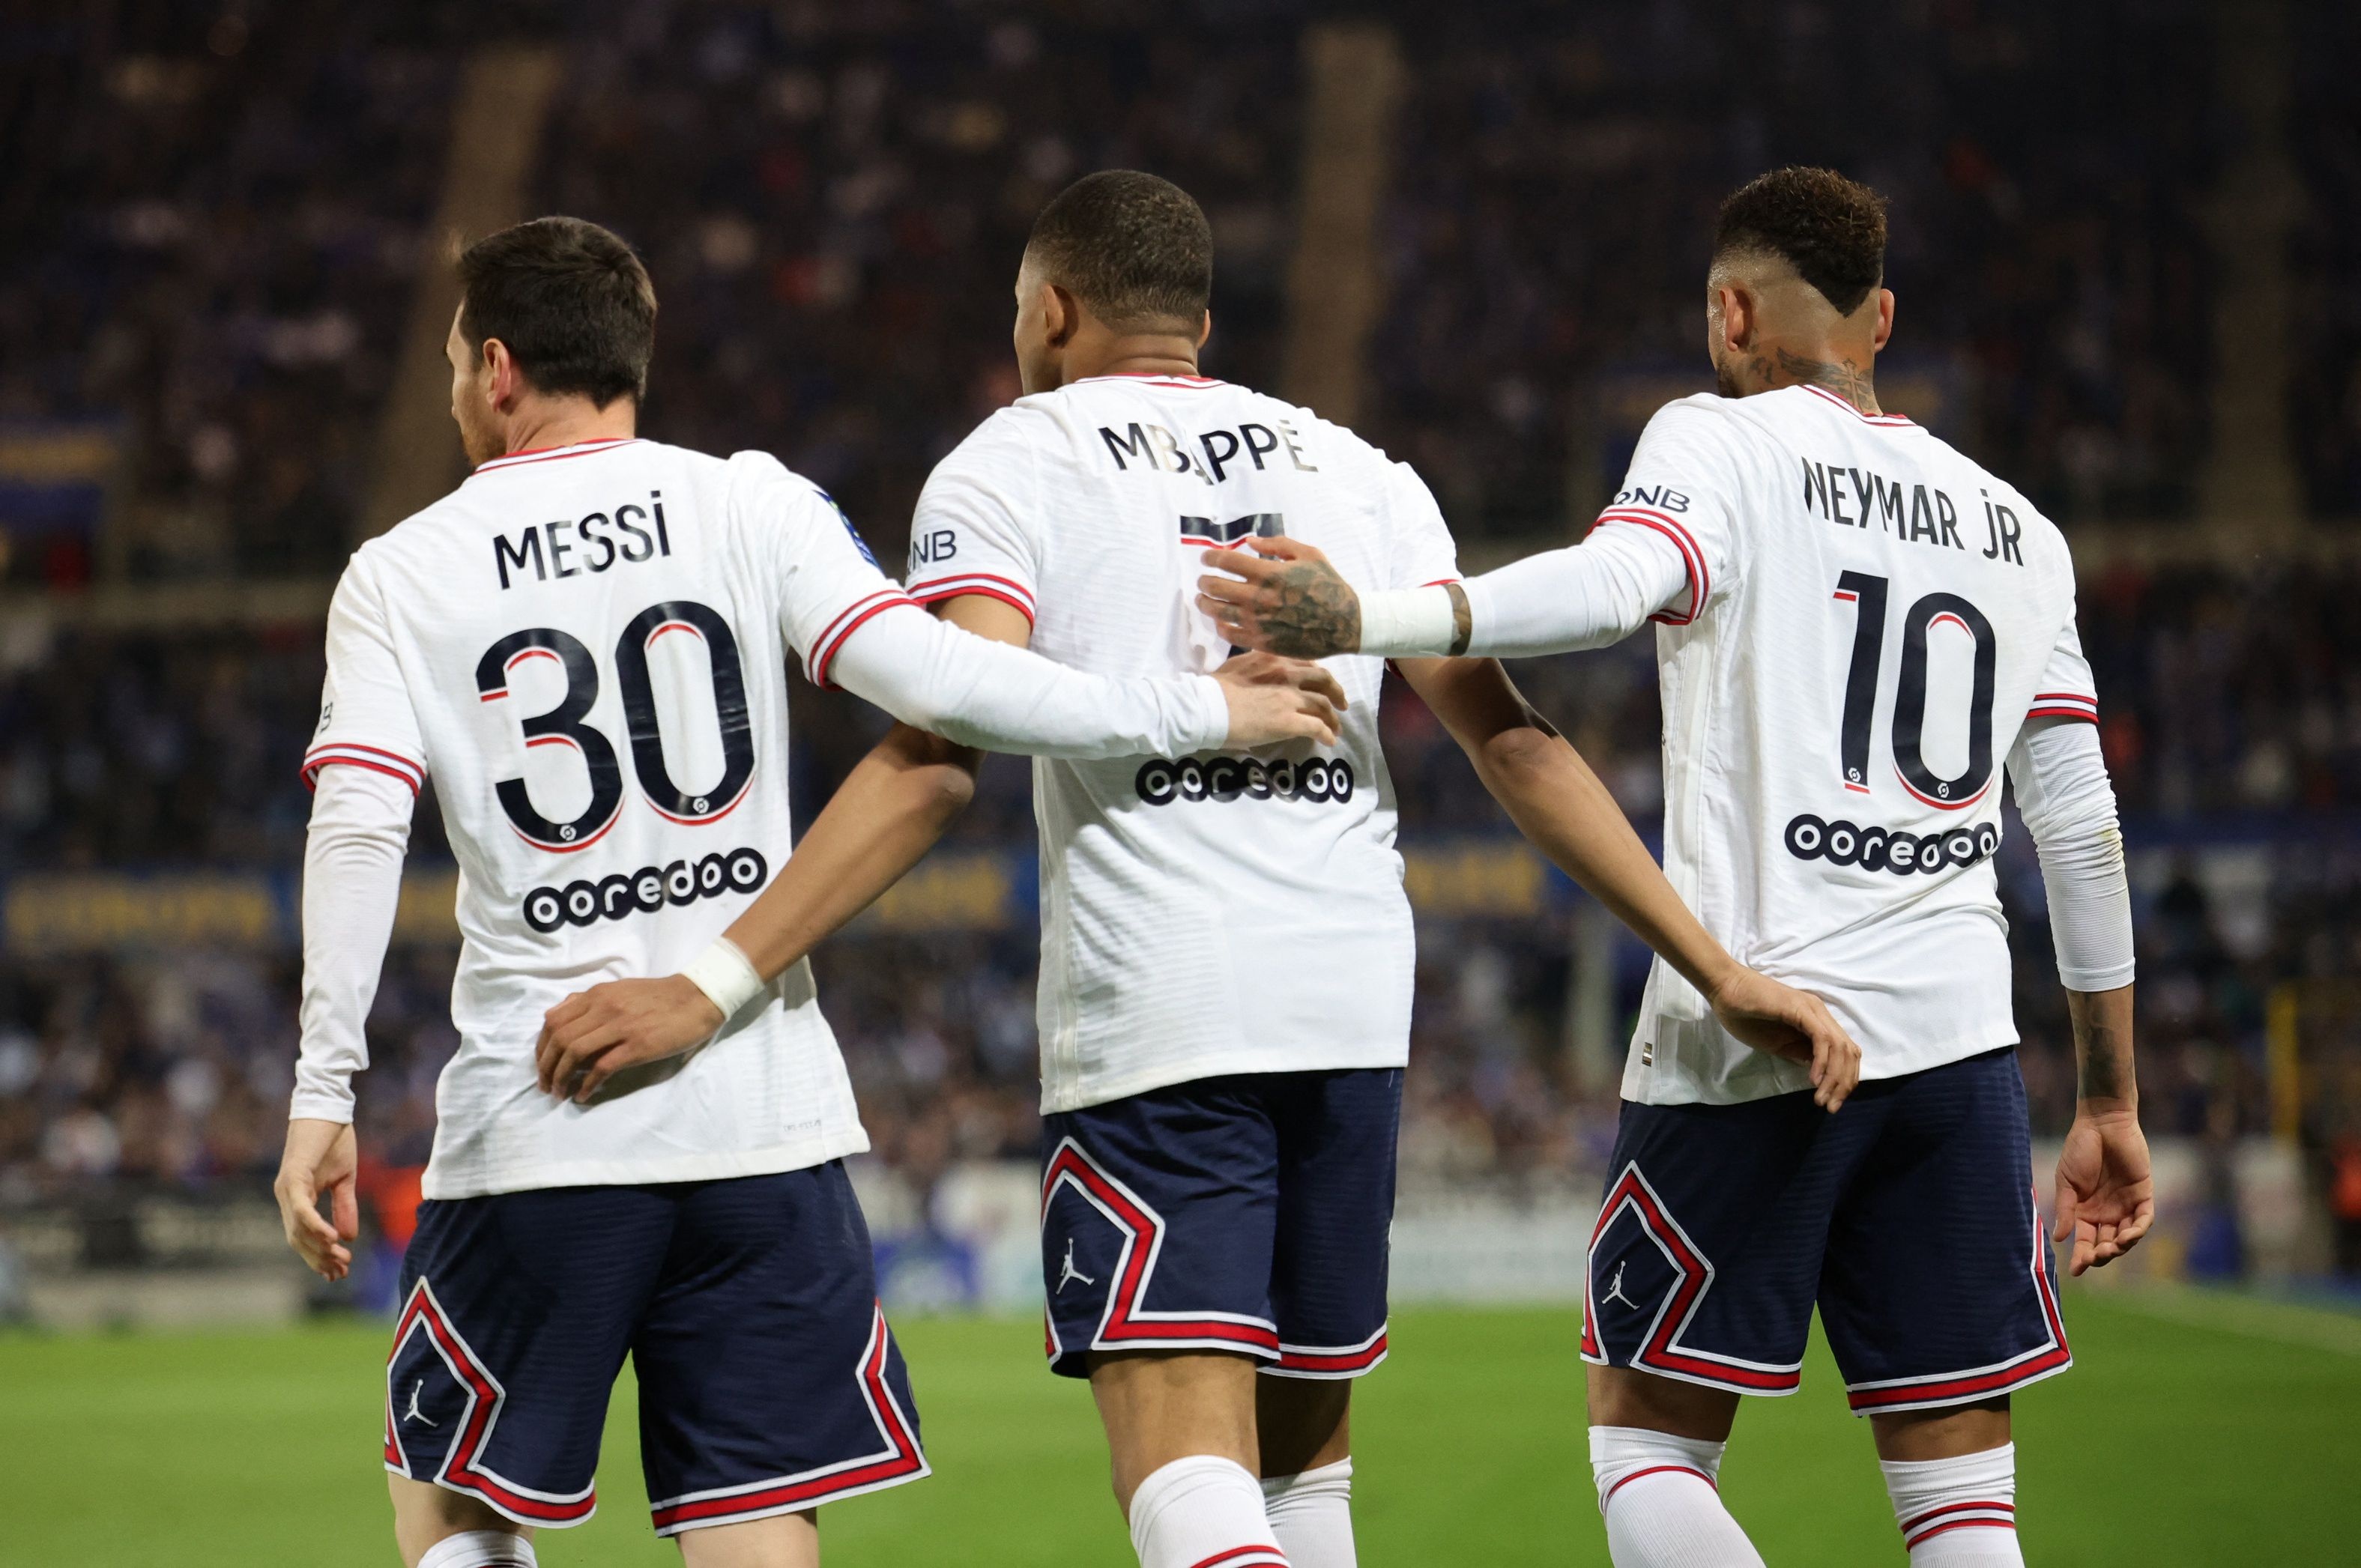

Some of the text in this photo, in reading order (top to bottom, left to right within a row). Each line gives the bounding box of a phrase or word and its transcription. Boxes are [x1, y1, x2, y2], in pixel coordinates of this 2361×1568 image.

[1801, 456, 1965, 550] NEYMAR
[907, 530, 957, 575] NB
[475, 601, 757, 853] 30
[1834, 570, 1997, 811] 10
[1136, 757, 1353, 805] ooredoo
[524, 847, 767, 933] ooredoo
